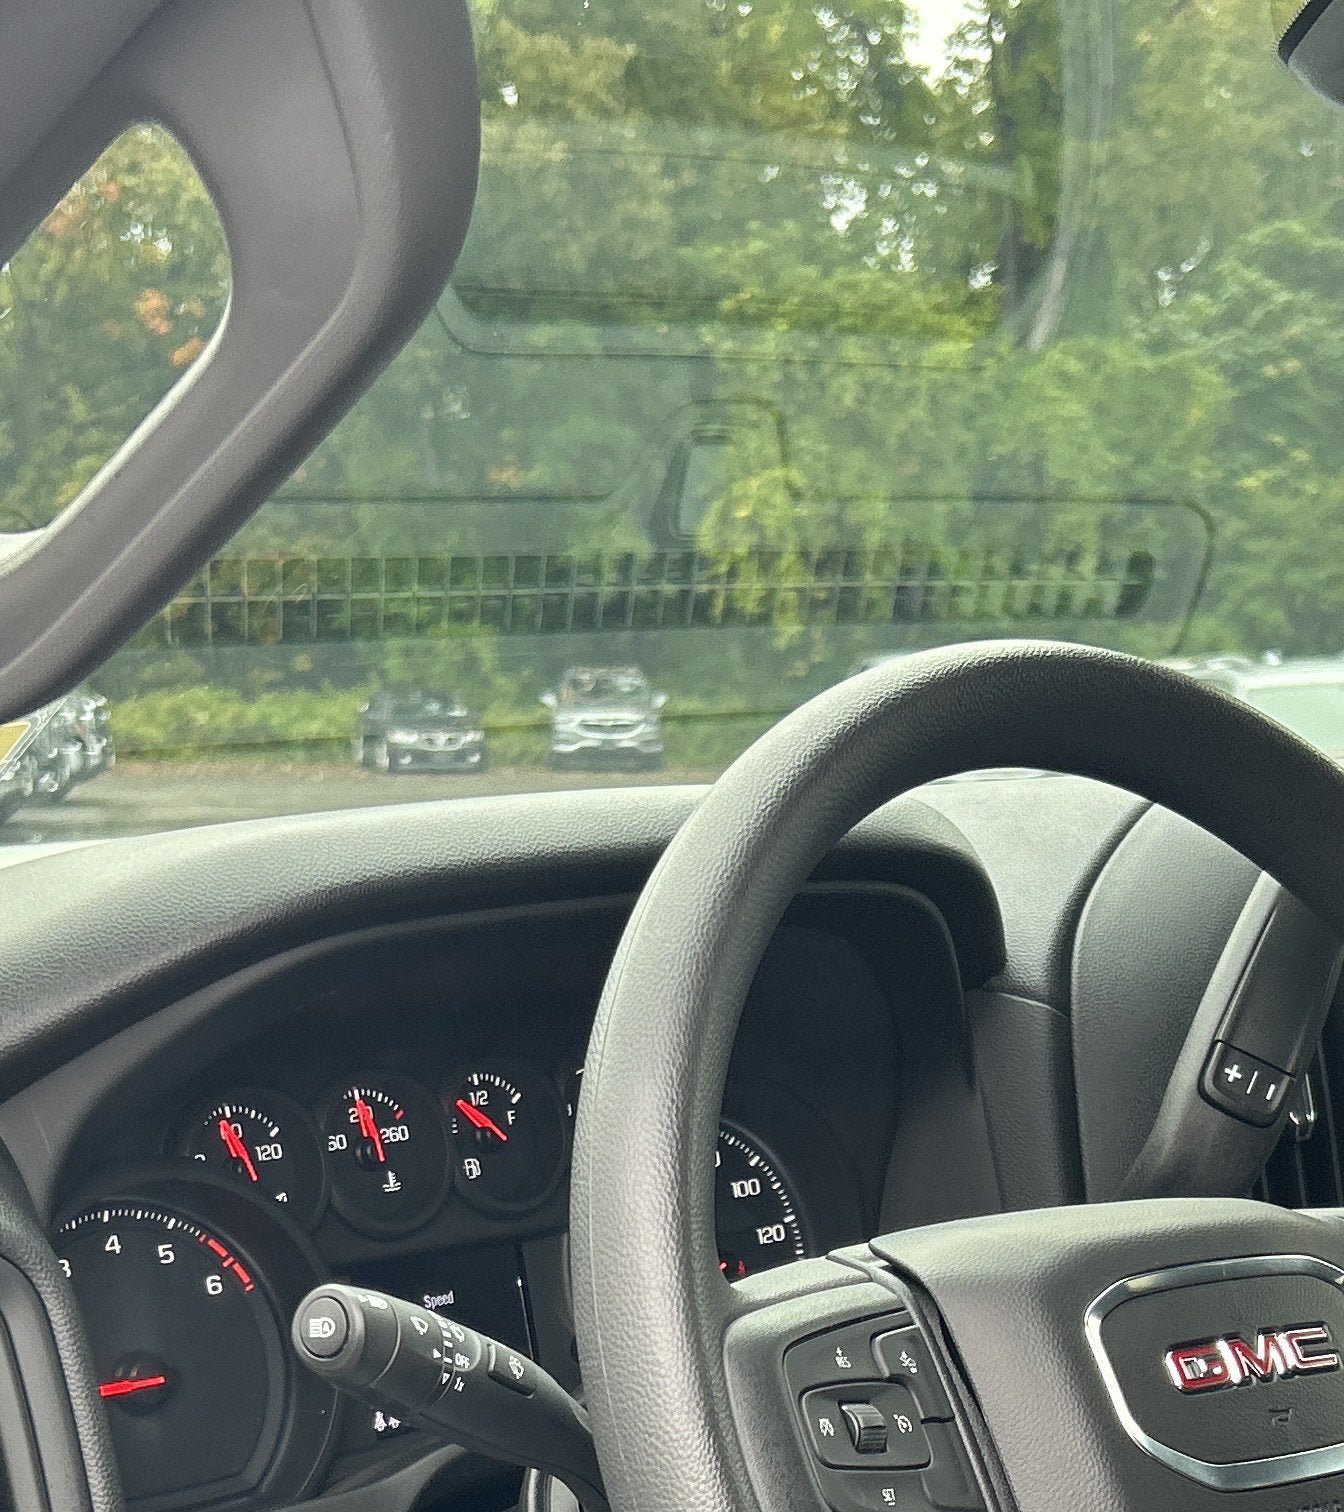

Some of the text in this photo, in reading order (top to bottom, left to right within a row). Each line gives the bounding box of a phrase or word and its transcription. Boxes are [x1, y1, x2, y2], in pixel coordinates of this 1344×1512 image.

[506, 1109, 516, 1125] F
[380, 1124, 410, 1143] 260
[254, 1143, 283, 1162] 120
[729, 1178, 762, 1199] 100
[104, 1234, 122, 1255] 4
[755, 1223, 787, 1246] 120
[157, 1243, 176, 1264] 5
[205, 1274, 224, 1296] 6
[423, 1290, 456, 1311] Speed
[455, 1352, 471, 1370] OFF
[1164, 1323, 1342, 1392] GMC
